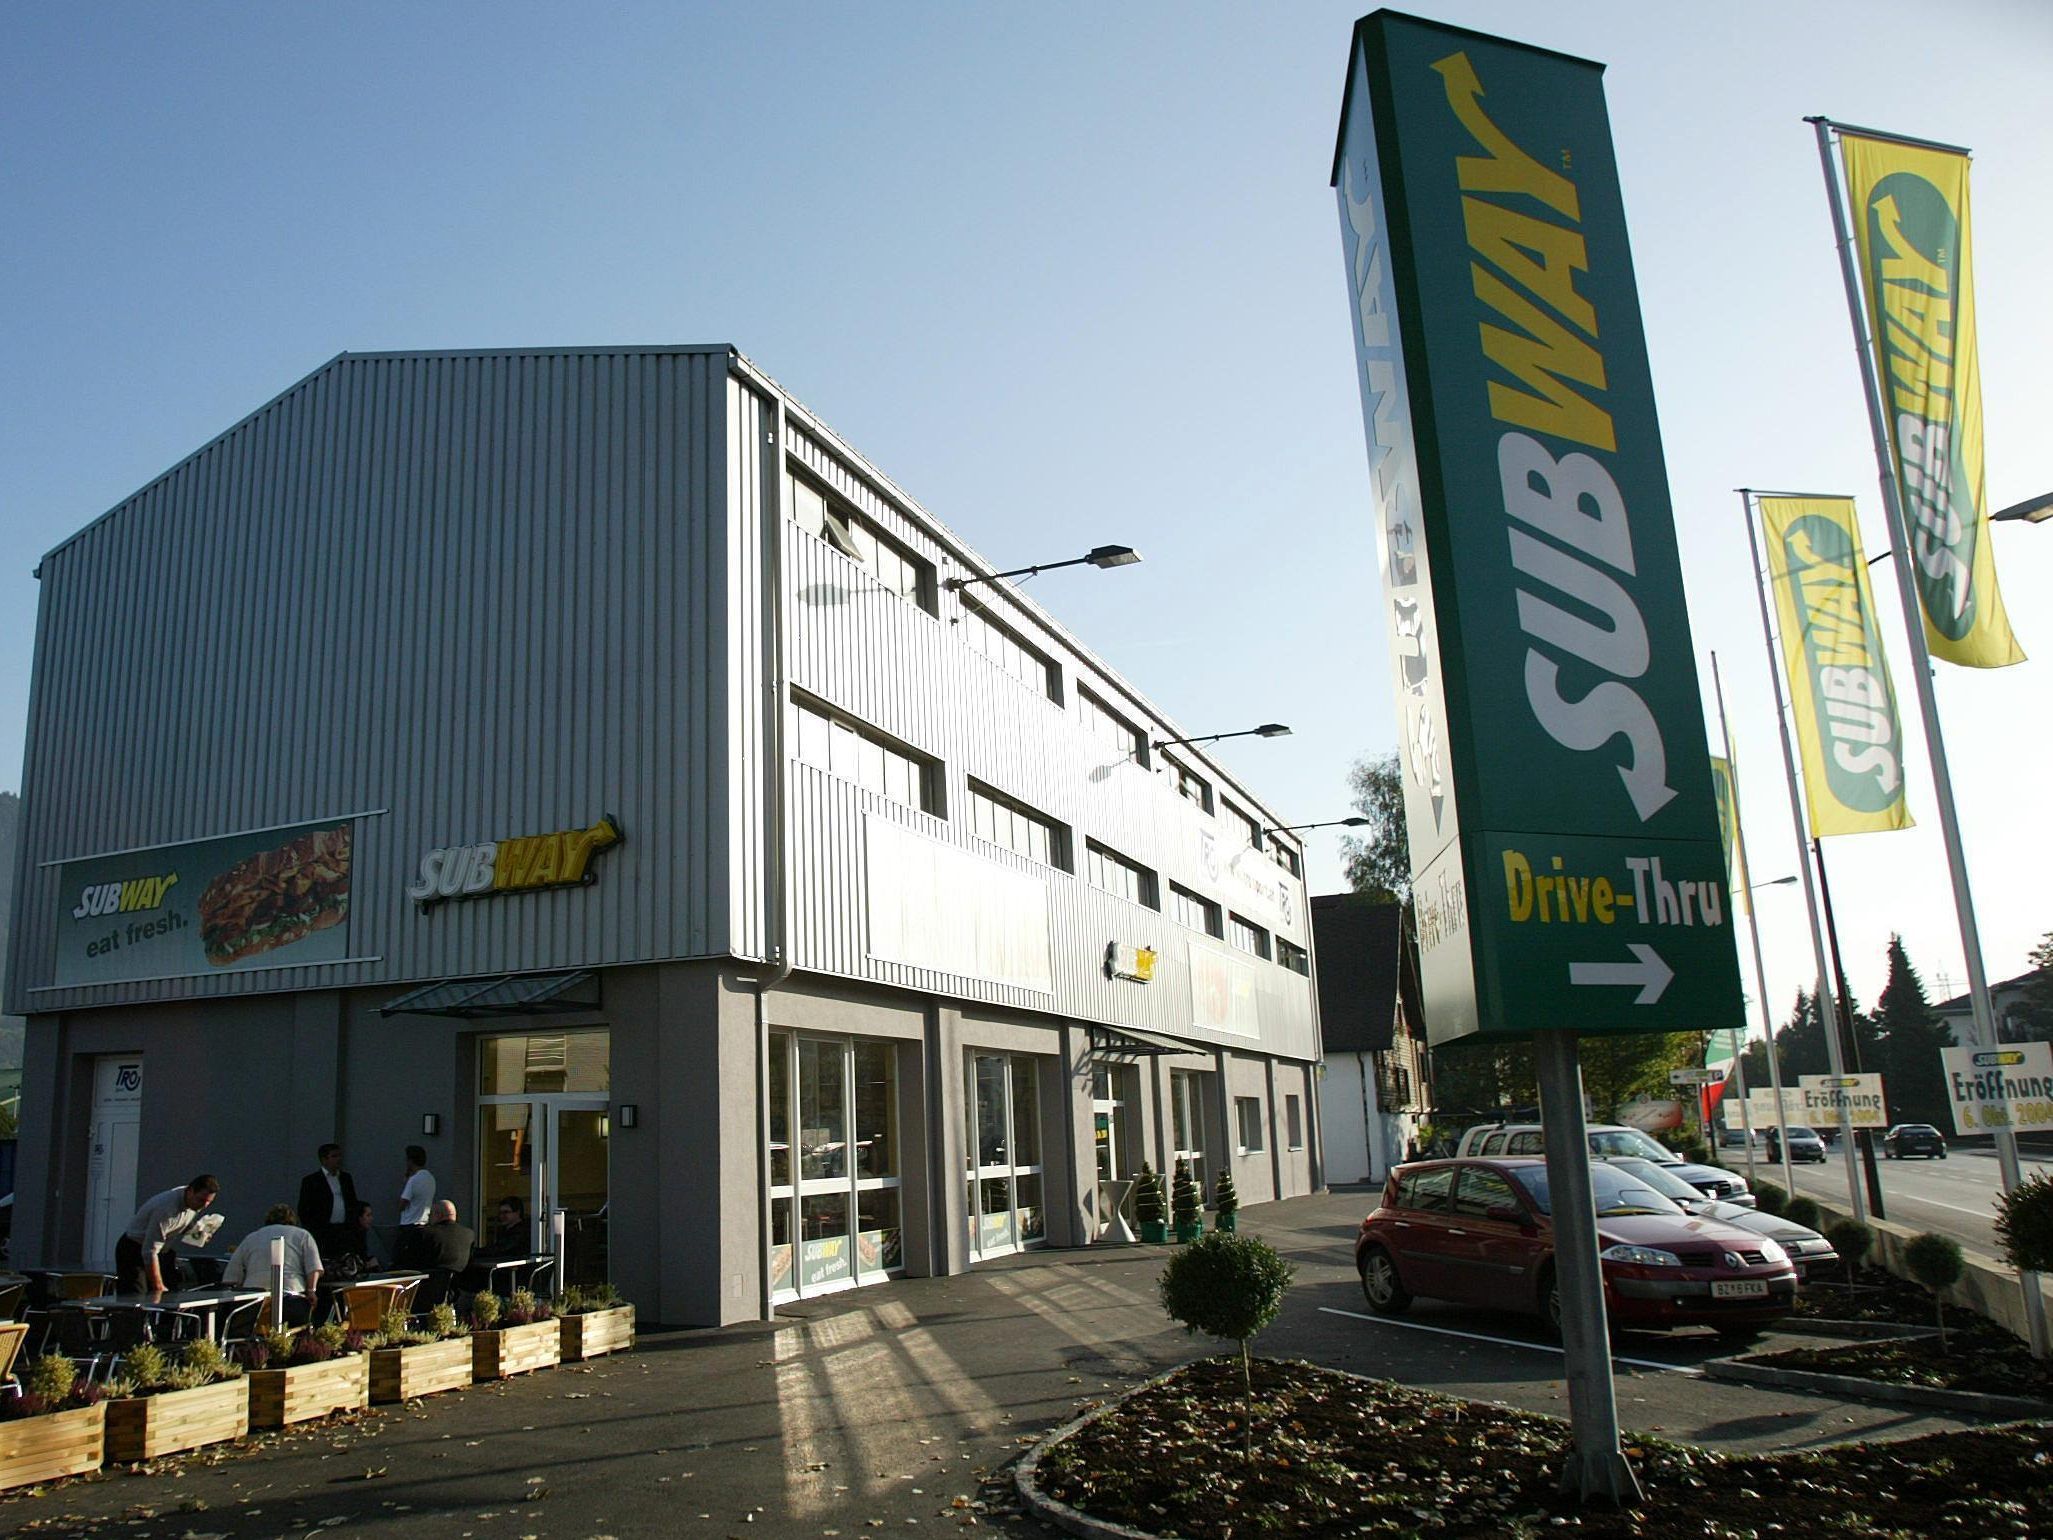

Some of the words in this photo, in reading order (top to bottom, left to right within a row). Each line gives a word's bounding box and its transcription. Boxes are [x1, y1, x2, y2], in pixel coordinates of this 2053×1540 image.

[1429, 50, 1680, 822] SUBWAY
[1870, 193, 1972, 620] SUBWAY
[1785, 528, 1901, 796] SUBWAY
[73, 871, 179, 920] SUBWAY
[405, 819, 617, 902] SUBWAY
[1502, 849, 1722, 927] Drive-Thru
[86, 929, 120, 958] eat
[126, 909, 188, 946] fresh.
[1804, 1089, 1881, 1110] Eröffnung
[1952, 1070, 2053, 1102] Eröffnung
